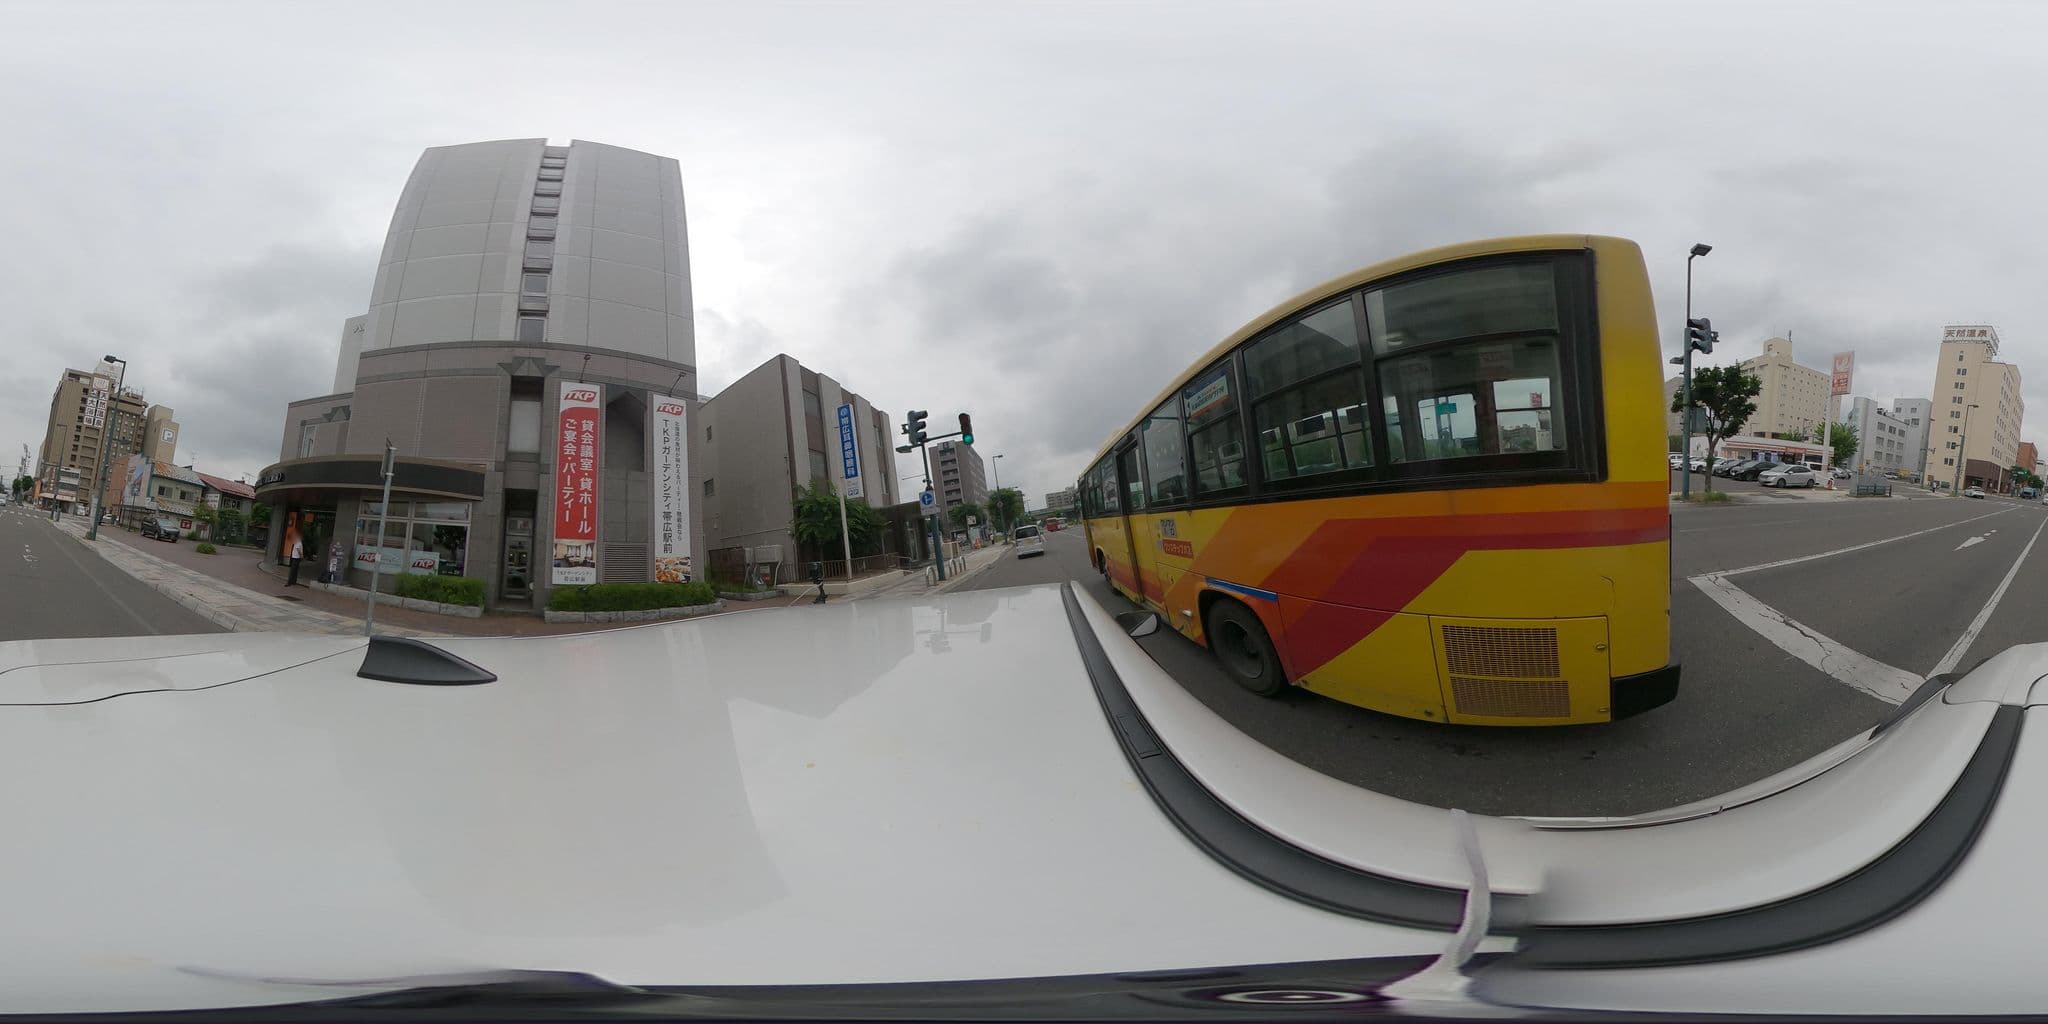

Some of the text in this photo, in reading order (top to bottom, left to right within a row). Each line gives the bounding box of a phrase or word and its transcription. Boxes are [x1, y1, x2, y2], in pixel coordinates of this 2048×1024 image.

[1945, 329, 1988, 338] 天然温泉
[564, 390, 597, 403] TKP
[656, 403, 684, 416] TKP
[562, 418, 577, 523] ご宴会・パーティー
[578, 419, 594, 534] 貸会議室・貸ホール
[411, 558, 435, 570] TKP
